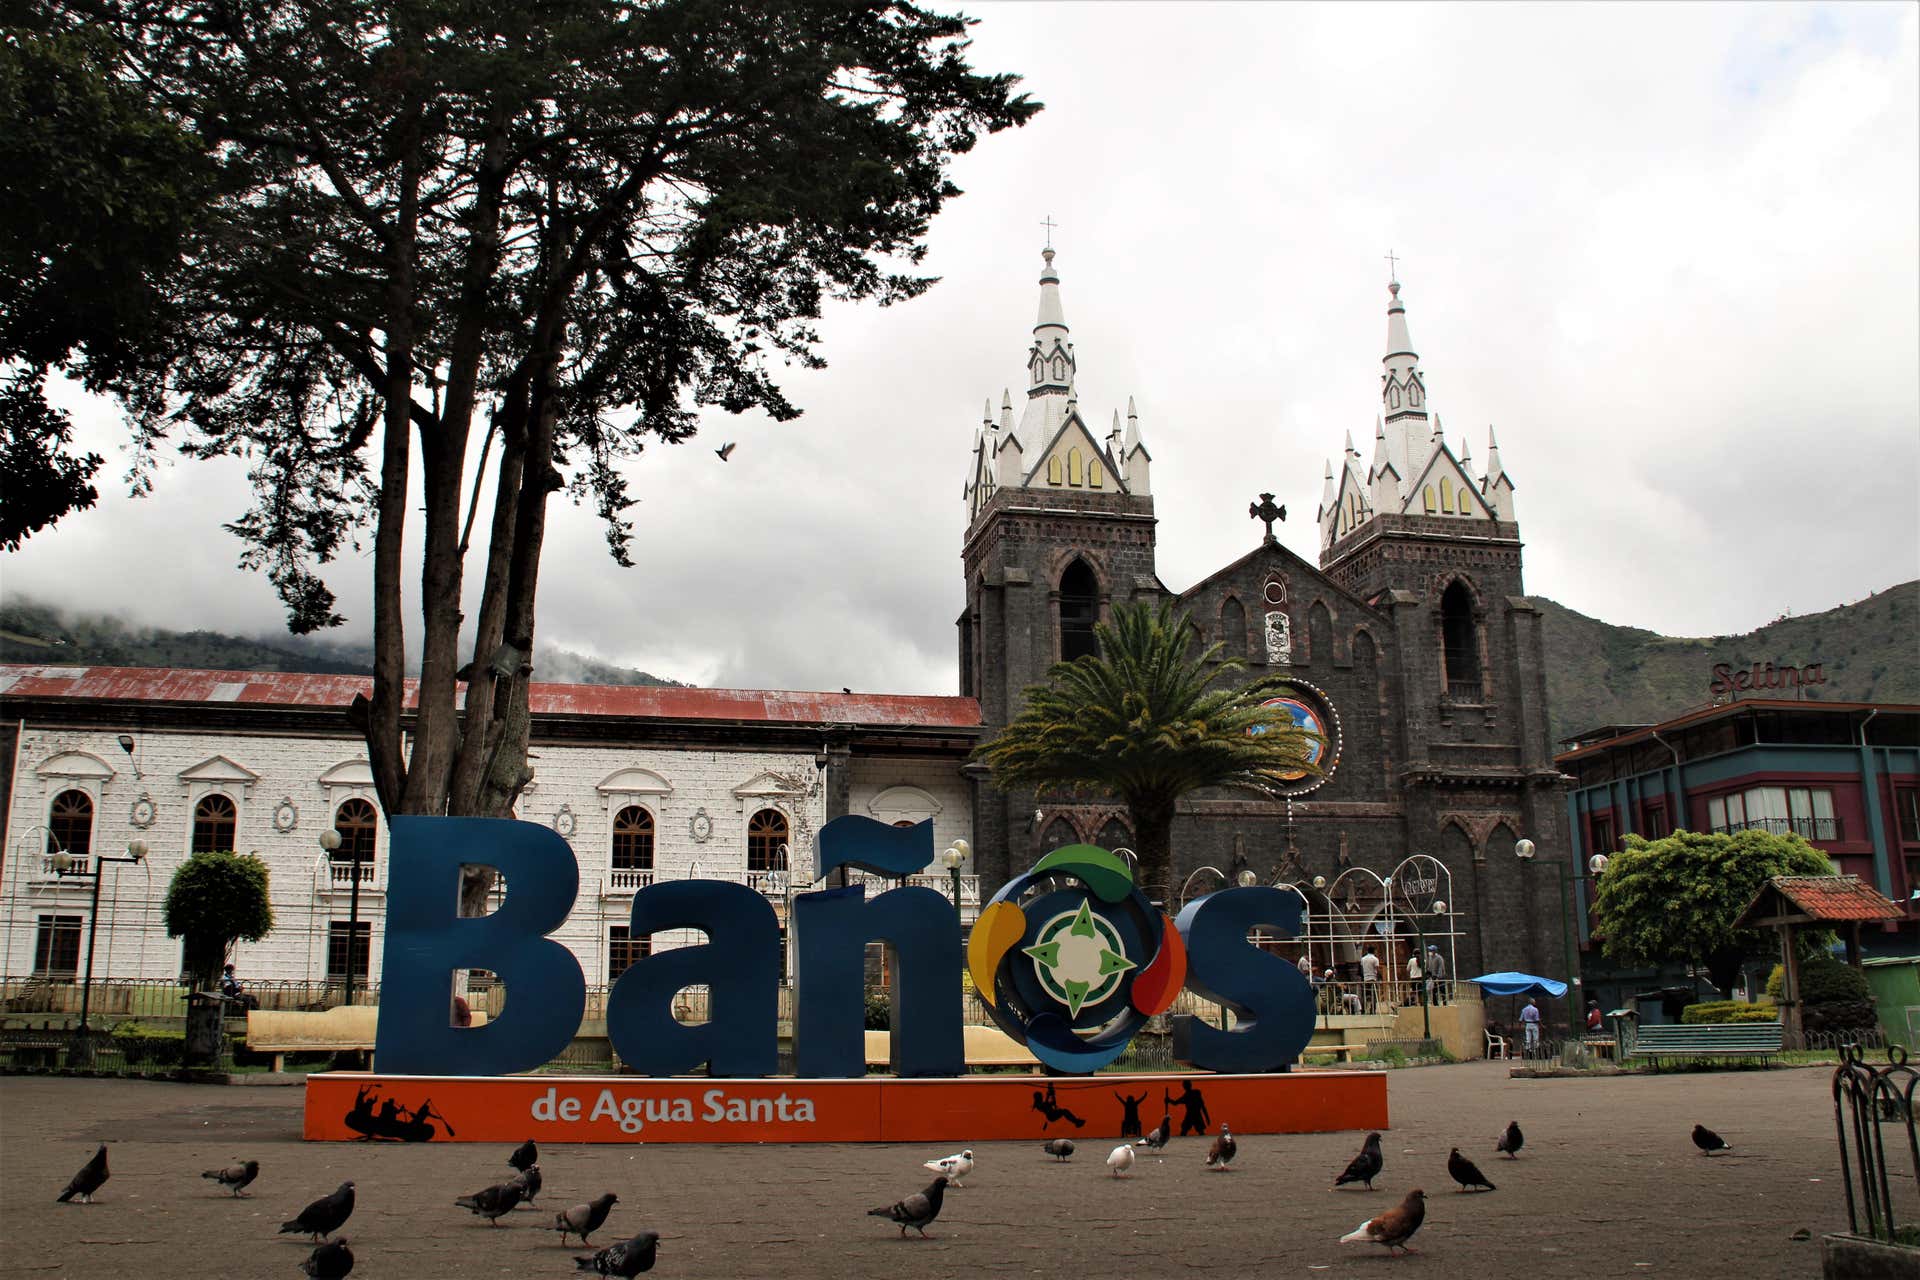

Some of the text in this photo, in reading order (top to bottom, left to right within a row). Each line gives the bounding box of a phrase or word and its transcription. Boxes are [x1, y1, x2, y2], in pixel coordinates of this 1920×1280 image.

[1710, 662, 1826, 695] Selina
[530, 1087, 817, 1134] de Agua Santa
